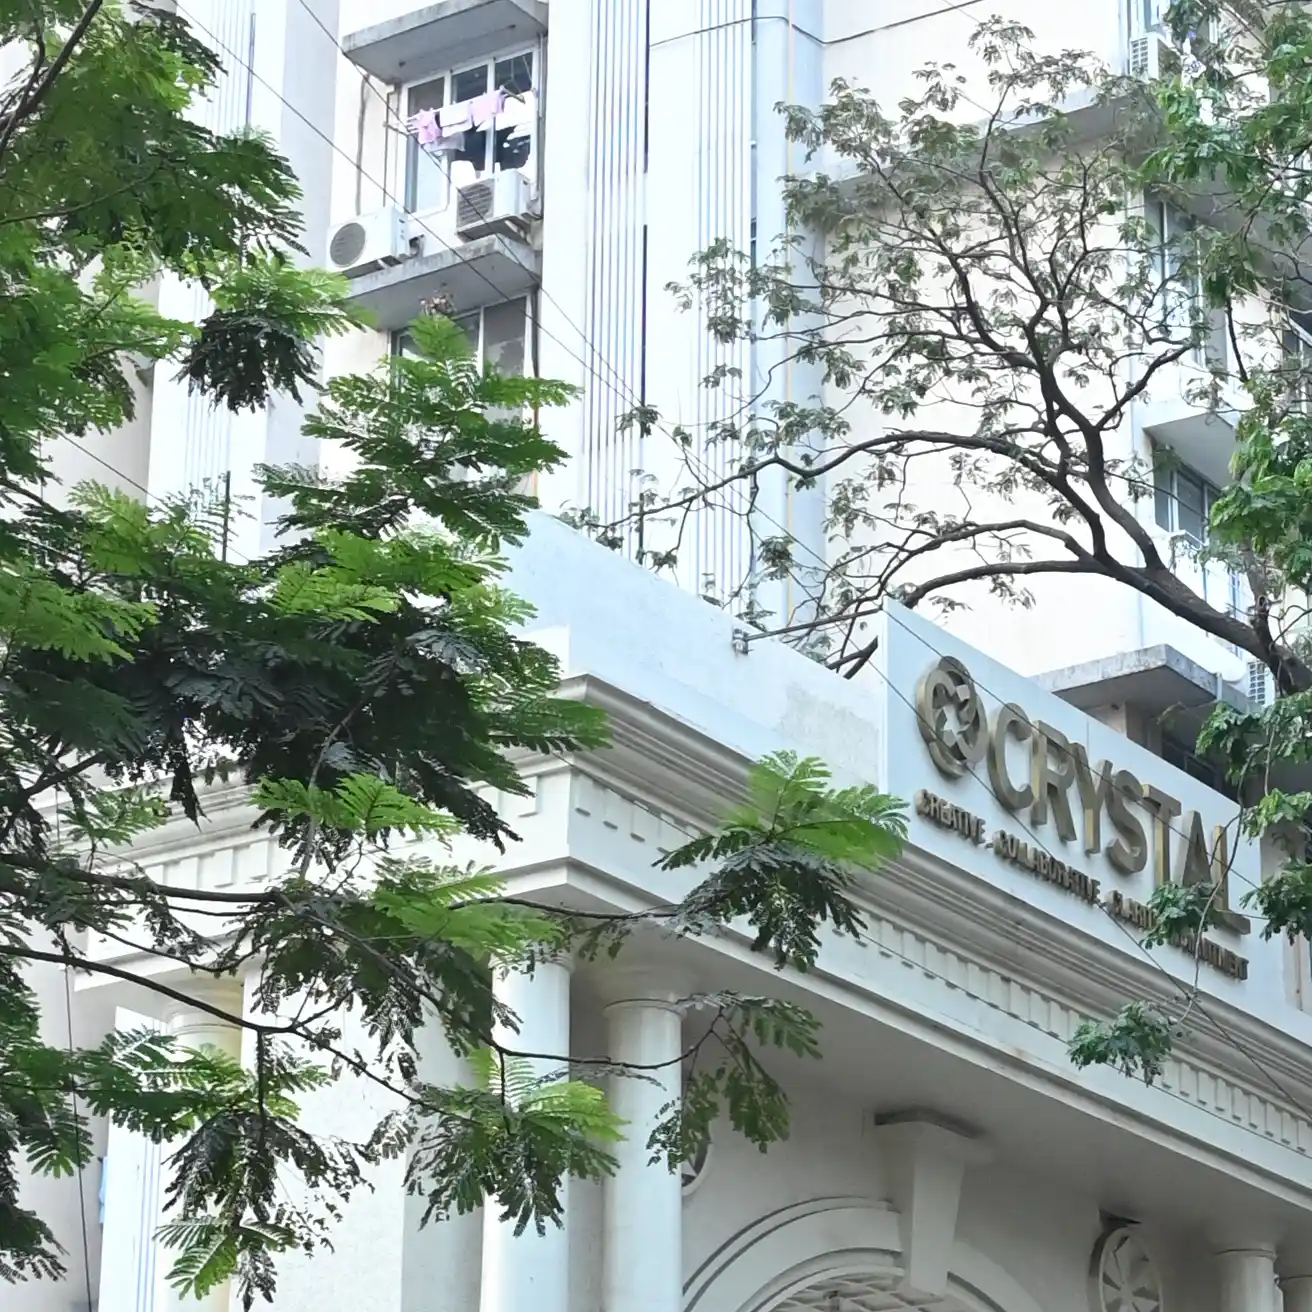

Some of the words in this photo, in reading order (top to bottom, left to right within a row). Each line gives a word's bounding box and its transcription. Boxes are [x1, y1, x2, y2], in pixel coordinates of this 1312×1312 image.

[915, 788, 986, 845] CREATIVE
[1106, 890, 1158, 931] CLARIT
[987, 701, 1251, 935] CRYSTAL
